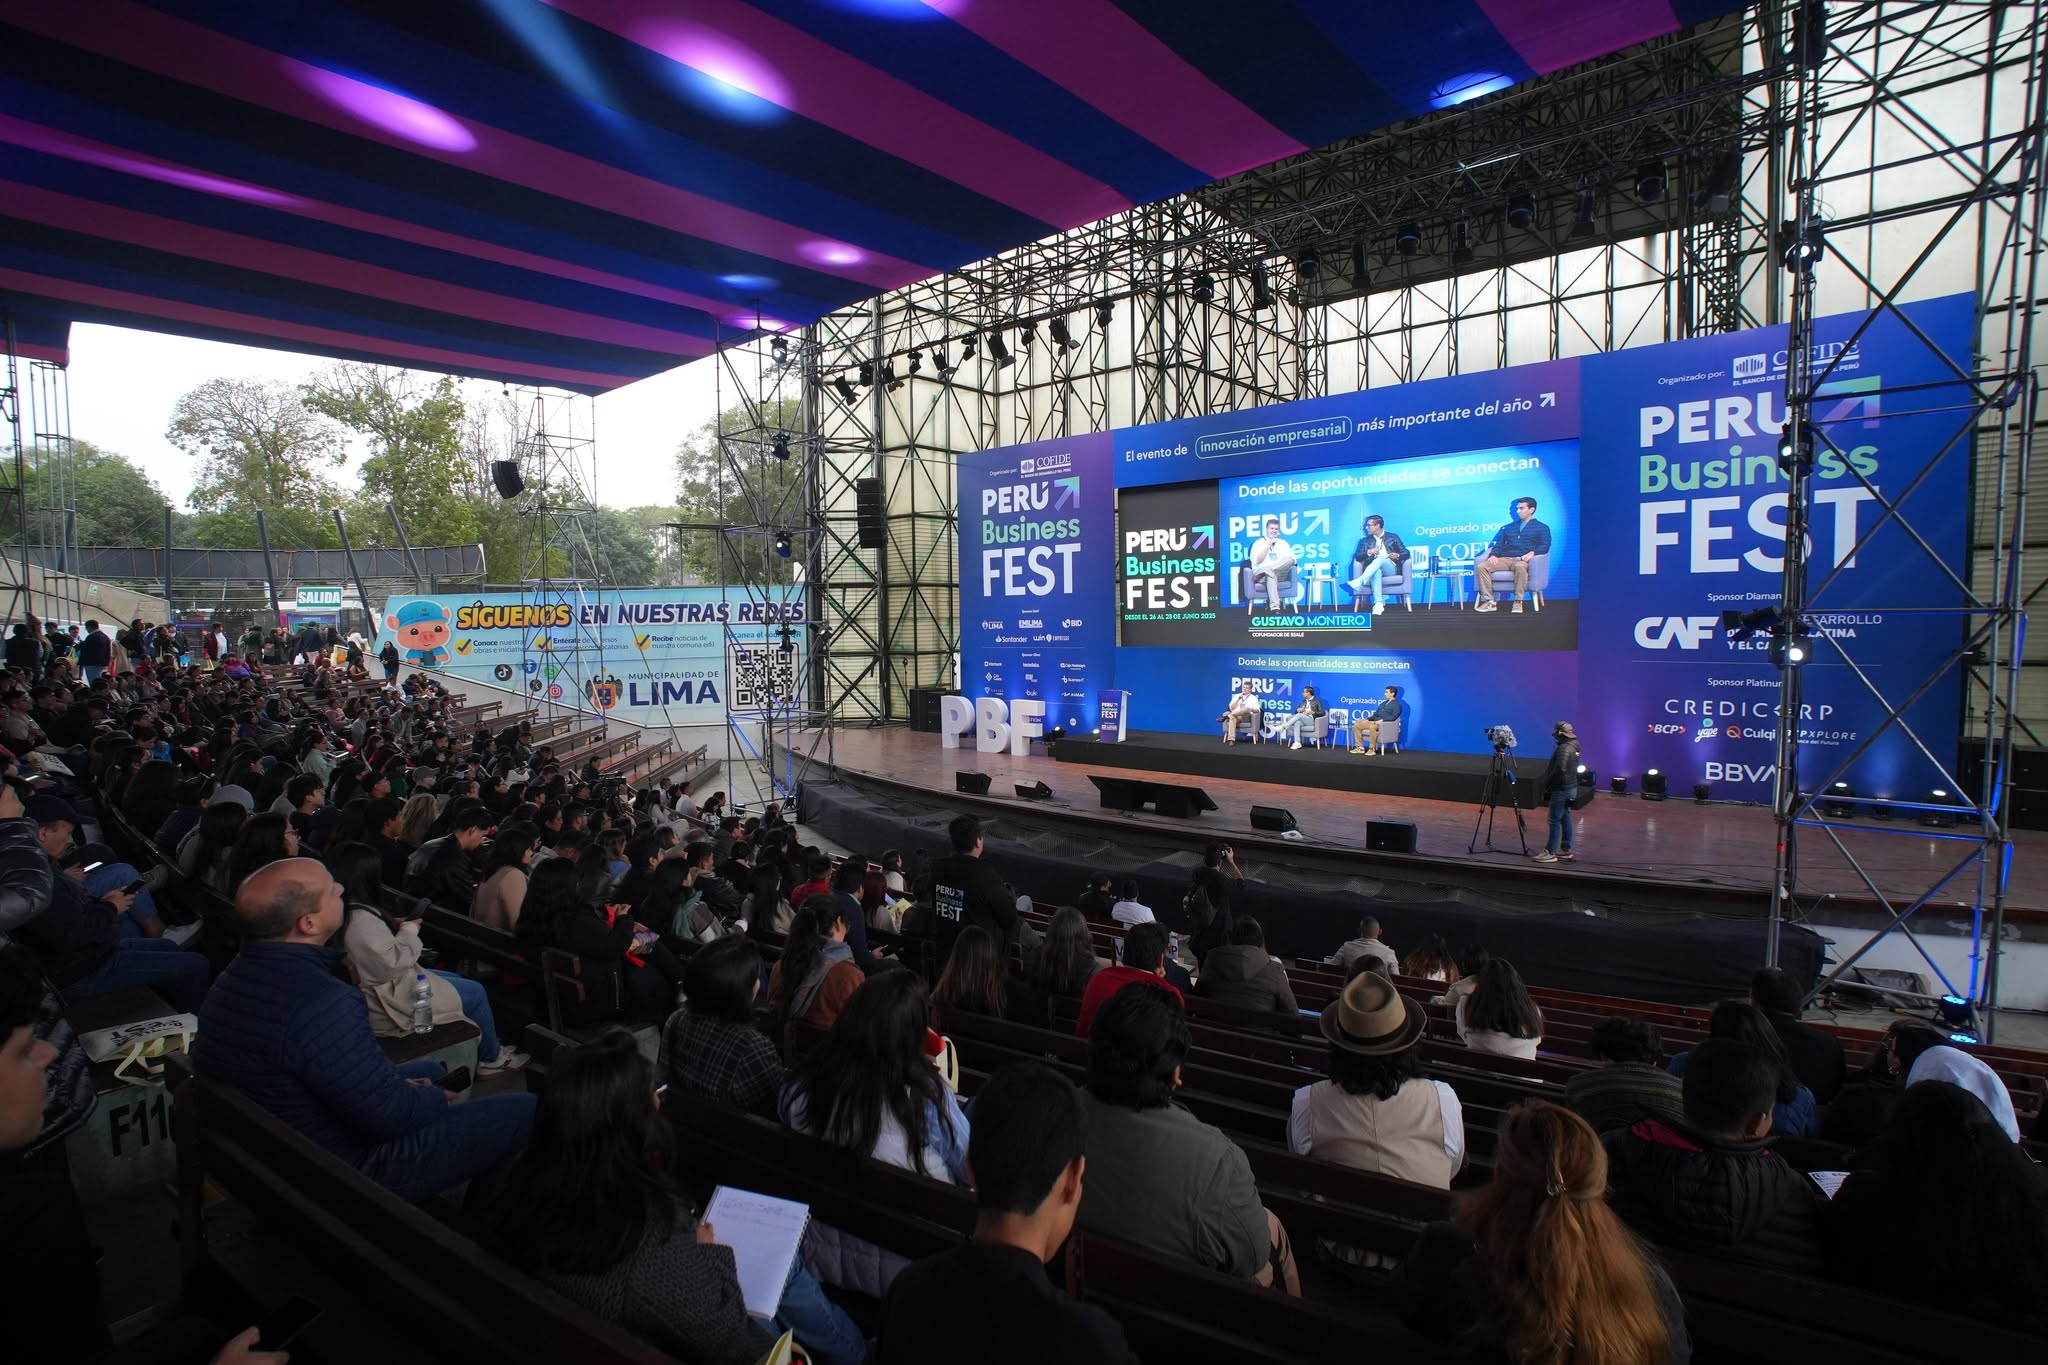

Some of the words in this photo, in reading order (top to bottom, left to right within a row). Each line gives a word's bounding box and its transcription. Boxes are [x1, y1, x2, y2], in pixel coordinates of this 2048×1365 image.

[1773, 339, 1860, 366] CFIDE
[1658, 373, 1706, 386] Organizado
[1708, 370, 1725, 382] por:
[1742, 377, 1766, 386] BANCO
[1767, 374, 1777, 382] DE
[1126, 451, 1134, 462] El
[1137, 447, 1171, 460] evento
[1174, 444, 1188, 456] de
[1200, 435, 1265, 453] innovación
[1268, 421, 1346, 446] empresarial
[1357, 415, 1385, 432] más
[1388, 408, 1470, 430] importante
[1475, 400, 1499, 416] del
[1503, 398, 1532, 413] año
[1037, 453, 1072, 468] COFIDE
[1640, 444, 1880, 493] Businss
[1239, 482, 1285, 498] Donde
[1288, 479, 1308, 493] las
[1312, 464, 1426, 493] oportunidades
[1431, 464, 1449, 479] se
[1455, 457, 1540, 477] conectan
[982, 481, 1049, 515] PERÚ
[982, 515, 1080, 545] Business
[1416, 522, 1480, 538] Organizado
[1640, 486, 1881, 575] FEST
[1126, 528, 1187, 553] PERÚ
[983, 543, 1081, 597] FEST
[1126, 555, 1215, 576] Business
[298, 592, 340, 604] SALIDA
[1126, 575, 1215, 610] FEST
[1707, 593, 1744, 602] Sponsor
[1746, 592, 1782, 601] Diaman
[457, 600, 573, 630] SÍGUENOS
[581, 605, 609, 624] EN
[618, 603, 729, 624] NUESTRAS
[738, 602, 805, 622] REDES
[1252, 616, 1304, 627] GUSTAVO
[1307, 615, 1365, 626] MONTERO
[1802, 614, 1883, 625] ESARROLLO
[988, 622, 1004, 630] LIMA
[1634, 616, 1720, 650] CAF
[1727, 641, 1736, 650] Y
[1738, 641, 1754, 650] EL
[1238, 657, 1266, 667] Donde
[1268, 658, 1280, 667] las
[1282, 658, 1348, 669] oportunidades
[1350, 661, 1362, 669] se
[1363, 660, 1410, 670] conectan
[628, 671, 706, 680] MUNICIPALIDAD
[1707, 678, 1744, 688] Sponsor
[629, 680, 720, 706] LIMA
[1340, 696, 1377, 705] Organizado
[1101, 711, 1118, 719] FEST
[941, 695, 1045, 756] PBF
[1654, 724, 1680, 734] BCP
[1694, 727, 1719, 743] yape
[1743, 727, 1776, 741] Culqi
[936, 901, 963, 922] FEST
